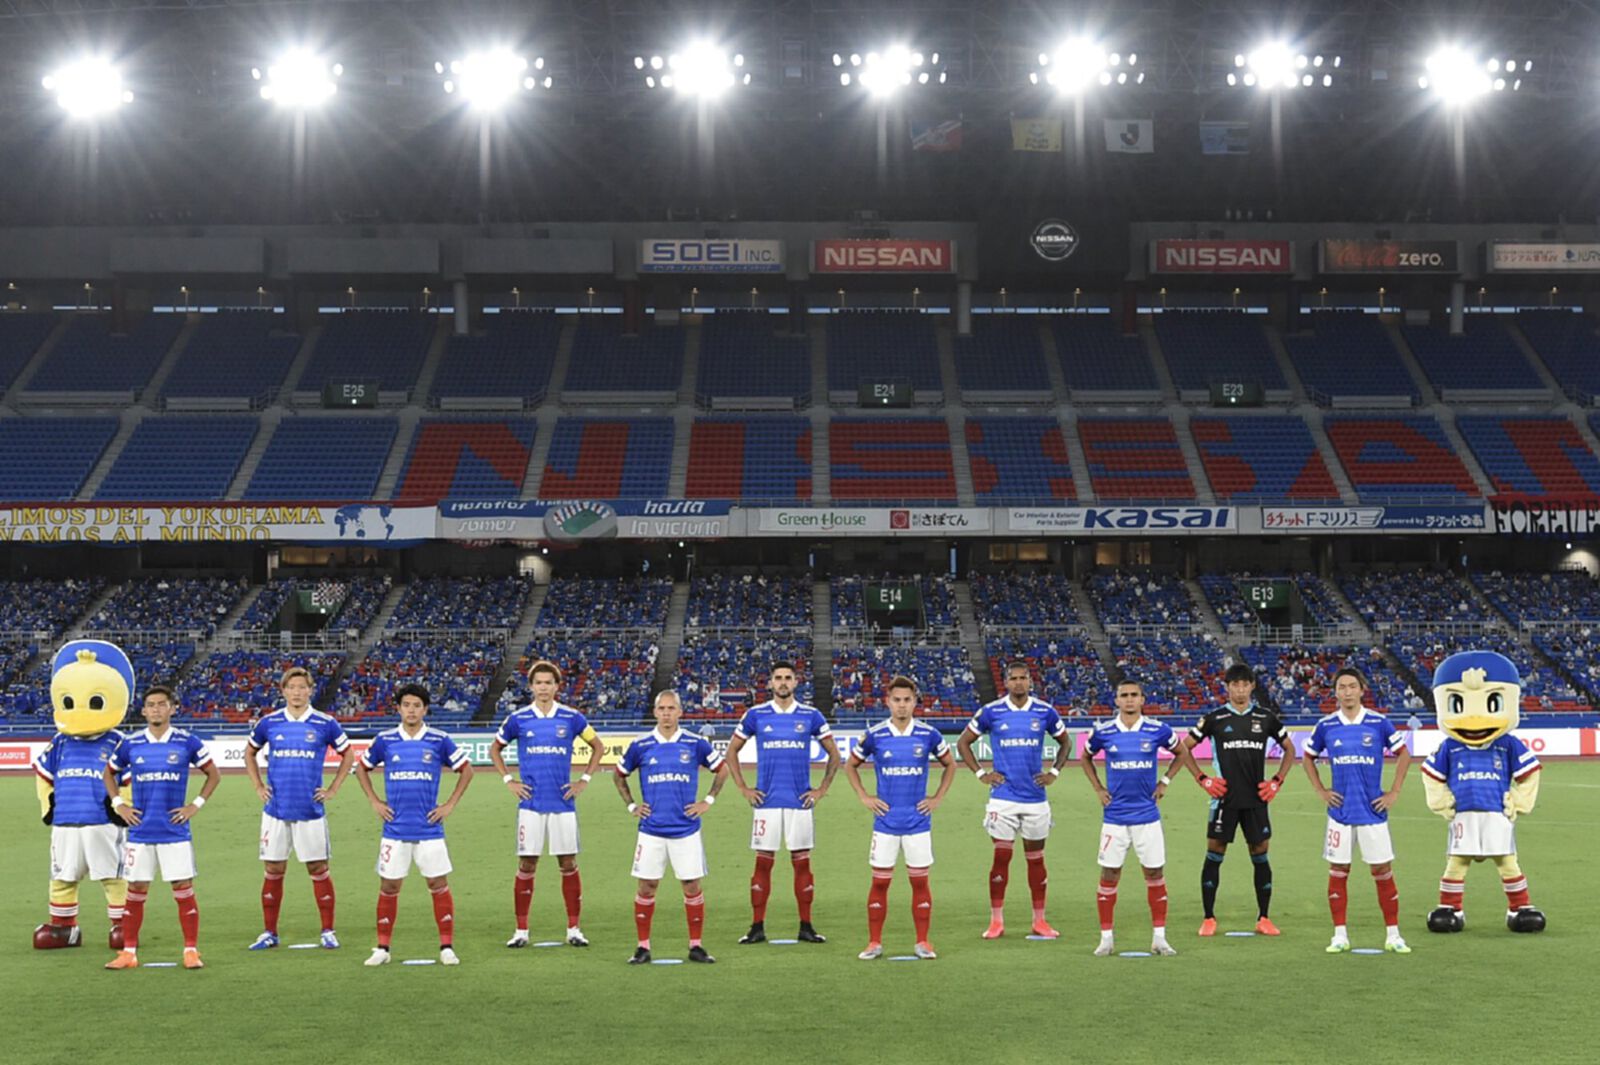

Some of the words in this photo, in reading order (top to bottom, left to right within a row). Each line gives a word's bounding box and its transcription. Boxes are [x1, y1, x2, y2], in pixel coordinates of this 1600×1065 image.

[653, 243, 738, 261] SOEI
[745, 250, 775, 261] INC.
[824, 248, 942, 266] NISSAN
[1166, 248, 1281, 266] NISSAN
[1399, 253, 1442, 266] zero
[343, 384, 365, 398] E25
[874, 384, 895, 397] E24
[1222, 383, 1244, 397] E23
[0, 507, 86, 525] IMOS
[94, 507, 150, 525] DEL
[161, 507, 324, 525] YOKOHAMA
[778, 512, 818, 526] Green
[821, 512, 866, 528] House
[160, 526, 270, 542] MUNDO
[880, 588, 902, 602] E14
[1252, 587, 1274, 601] E13
[527, 746, 567, 755] NISSAN
[763, 741, 805, 750] NISSAN
[1223, 740, 1263, 750] NISSAN
[273, 750, 315, 760] NISSAN
[1333, 756, 1375, 765] NISSAN
[1110, 761, 1153, 770] NISSAN
[57, 768, 104, 779] NISSAN
[136, 772, 180, 782] NISSAN
[390, 772, 433, 781] NISSAN
[648, 773, 691, 783] NISSAN
[1458, 771, 1501, 781] NISSAN
[754, 819, 766, 837] 13
